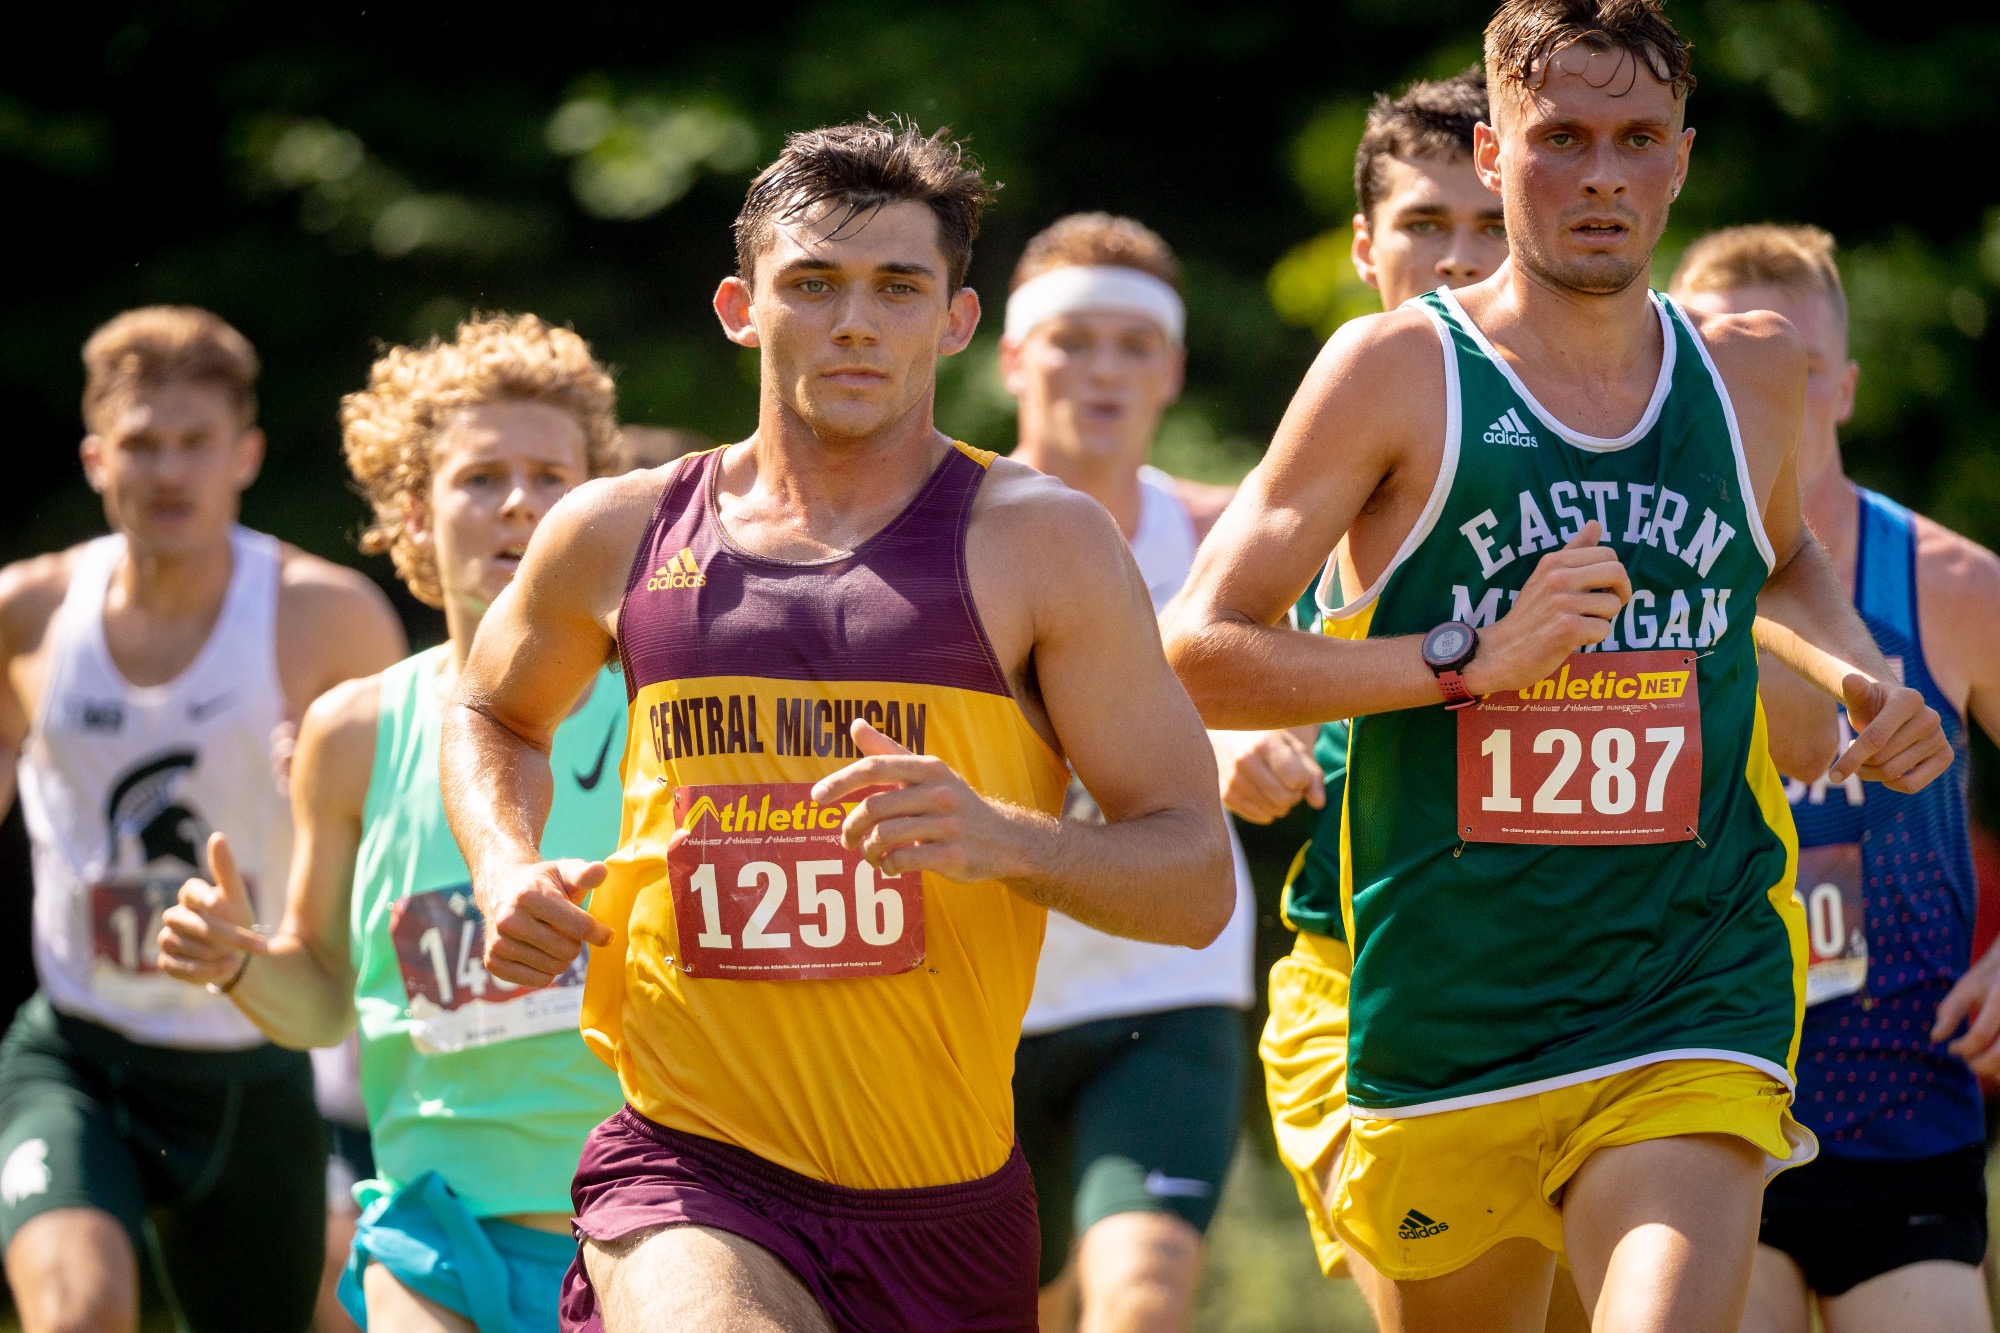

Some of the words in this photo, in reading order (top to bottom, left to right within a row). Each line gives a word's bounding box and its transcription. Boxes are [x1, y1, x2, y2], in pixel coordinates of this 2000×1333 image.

[1483, 430, 1538, 448] adidas
[1459, 480, 1736, 580] EASTERN
[647, 571, 707, 592] adidas
[650, 695, 764, 763] CENTRAL
[1481, 726, 1685, 815] 1287
[681, 793, 842, 834] Athletic
[689, 859, 905, 950] 1256
[1398, 1221, 1449, 1240] adidas
